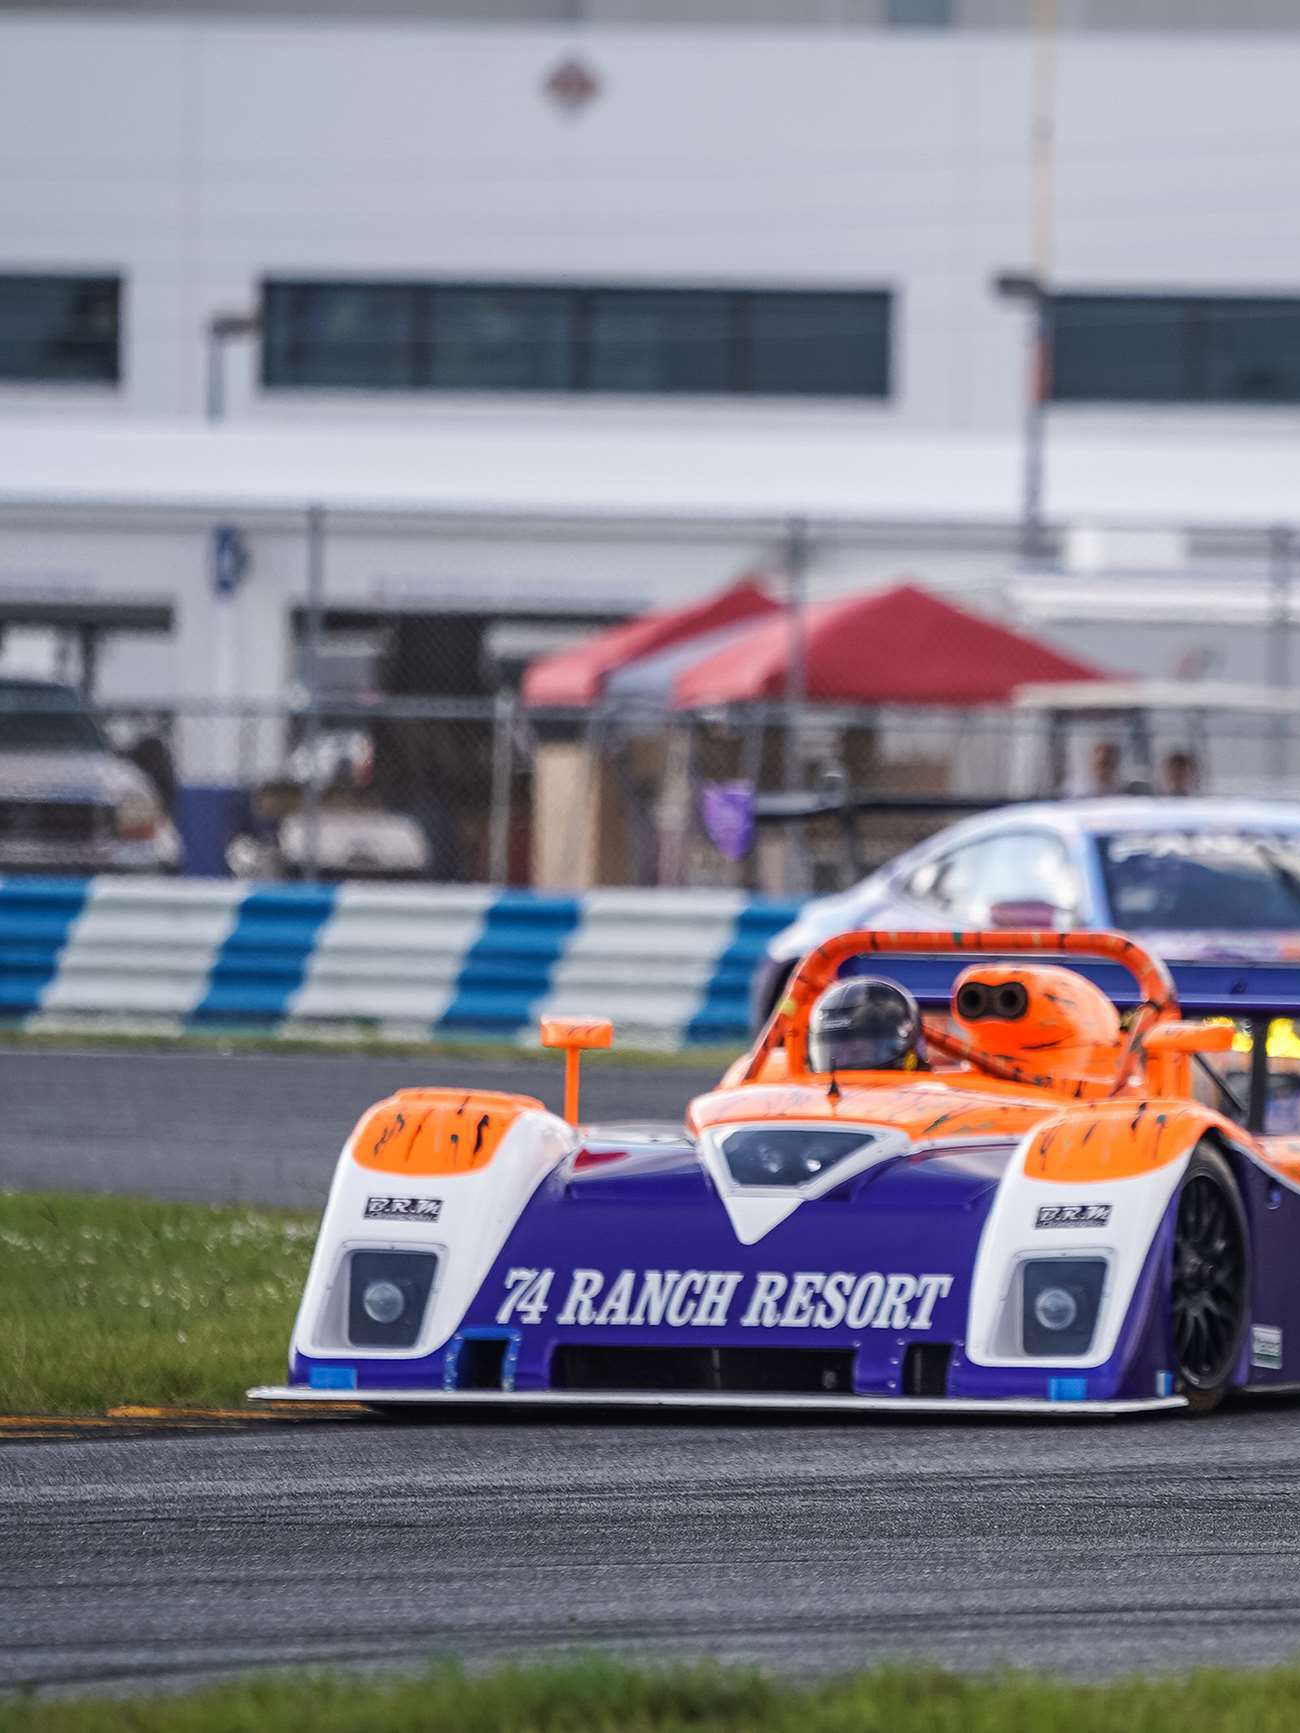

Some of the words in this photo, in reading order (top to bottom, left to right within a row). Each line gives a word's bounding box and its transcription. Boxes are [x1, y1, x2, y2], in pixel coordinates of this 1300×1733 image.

[498, 1269, 554, 1324] 74
[558, 1271, 741, 1328] RANCH
[743, 1273, 952, 1329] RESORT
